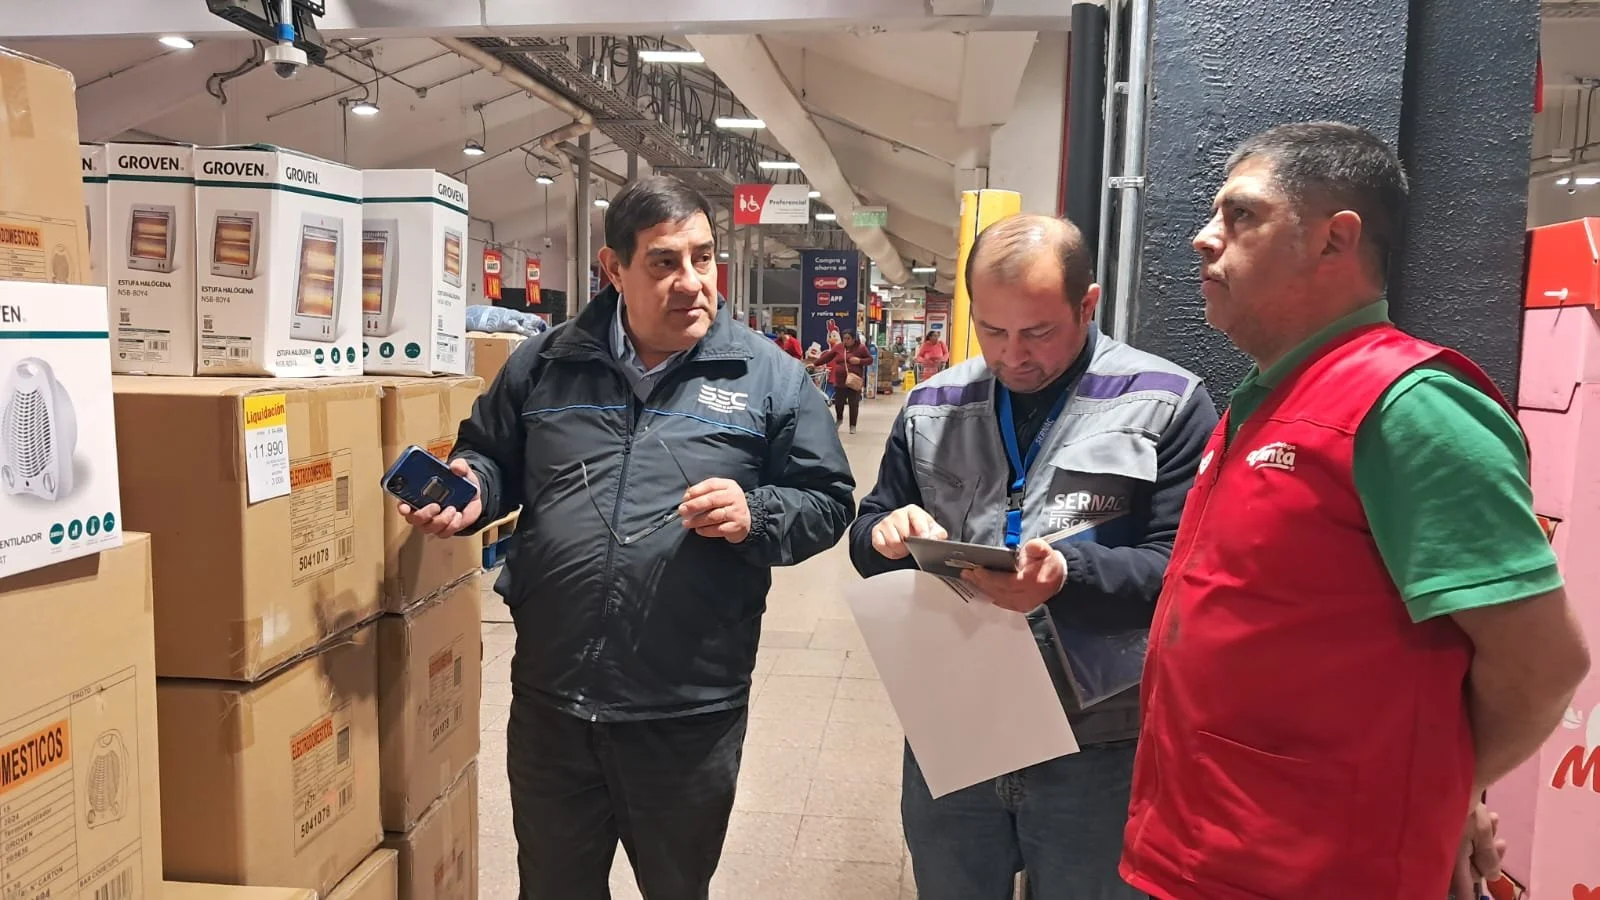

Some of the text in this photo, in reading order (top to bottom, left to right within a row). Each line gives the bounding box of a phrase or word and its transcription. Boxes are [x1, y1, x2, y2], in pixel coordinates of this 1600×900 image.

[118, 155, 179, 171] GROVEN
[203, 161, 264, 176] GROVEN
[286, 166, 318, 185] GROVEN
[438, 183, 464, 202] GROVEN
[815, 256, 840, 264] Compra
[118, 279, 171, 288] ESTUFA HALÓGENA
[201, 285, 254, 295] ESTUFA HALÓGENA
[698, 384, 748, 410] SEC
[246, 403, 285, 425] Liquidación
[1034, 416, 1055, 446] SERNAC
[253, 440, 284, 459] 11.990
[1054, 492, 1125, 511] SERNAC
[299, 548, 329, 571] 5041078
[72, 687, 92, 701] PHOTO
[4, 812, 19, 827] 2024
[4, 807, 53, 838] Termoventilador
[301, 805, 331, 838] 5041078
[5, 830, 33, 852] GROVEN
[38, 865, 64, 886] CARTON
